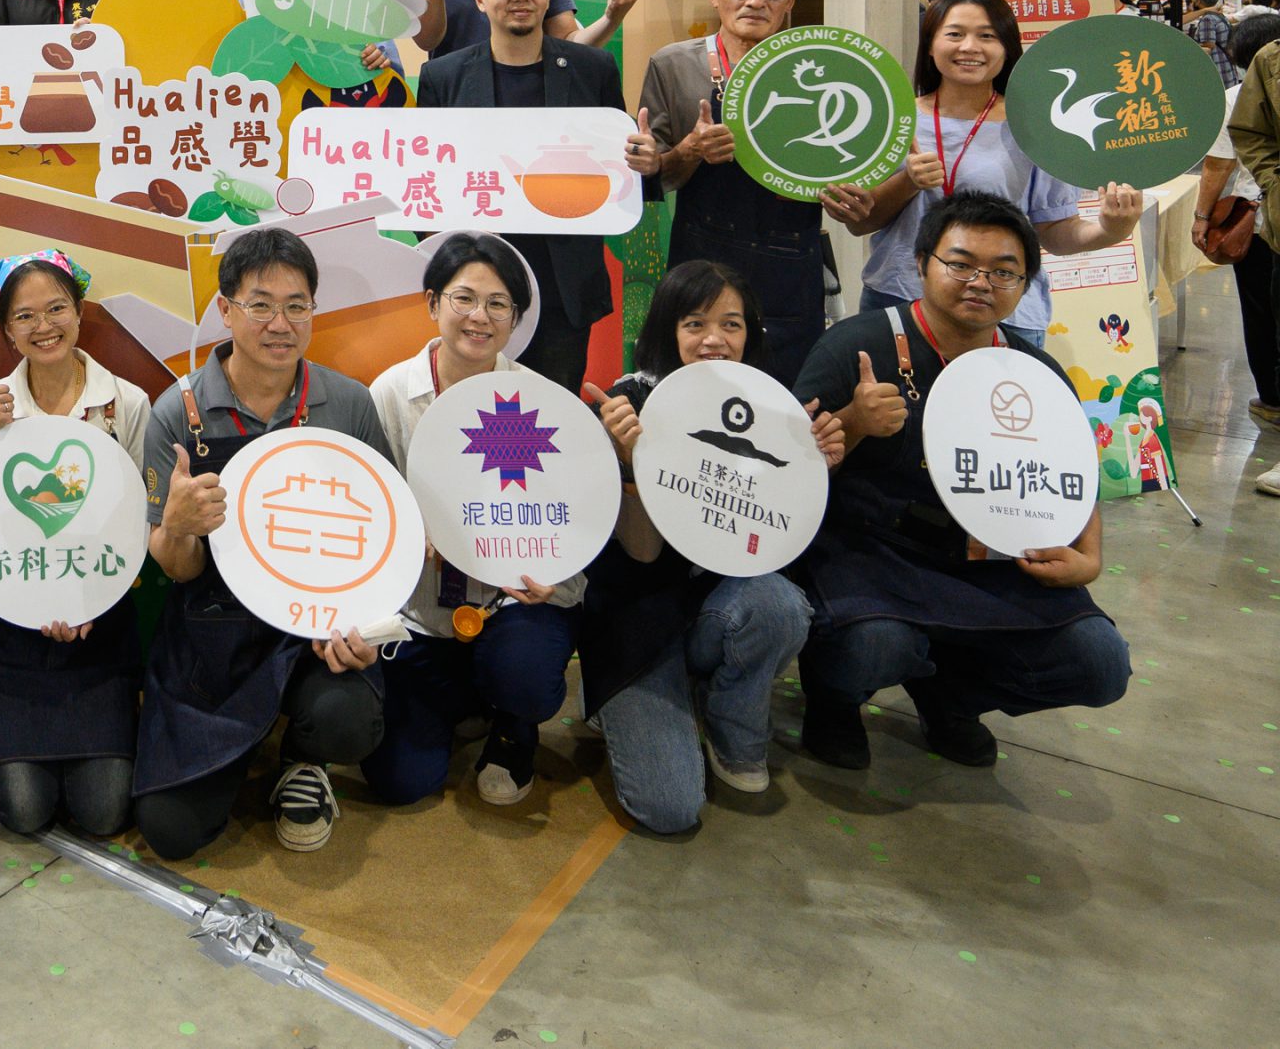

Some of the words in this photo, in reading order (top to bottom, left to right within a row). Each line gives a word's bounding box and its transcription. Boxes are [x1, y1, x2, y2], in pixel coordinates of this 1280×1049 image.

[726, 48, 769, 120] SIANG-TING
[771, 29, 839, 51] ORGANIC
[843, 33, 884, 60] FARM
[114, 78, 270, 118] Hualien
[111, 121, 271, 171] 品感覺
[302, 127, 456, 167] Hualien
[848, 162, 890, 188] FFEE
[886, 115, 912, 163] BEANS
[1105, 133, 1148, 150] ARCADIA
[1148, 127, 1188, 142] RESORT
[342, 170, 505, 219] 品感覺
[699, 458, 757, 491] 旦茶六十
[951, 448, 1083, 501] 里山微田
[656, 469, 791, 532] LIOUSHIHDAN
[989, 505, 1020, 517] SWEET
[1024, 510, 1055, 521] MANOR
[701, 507, 738, 535] TEA
[475, 537, 512, 558] NITA
[516, 532, 562, 558] CAFÉ
[288, 602, 338, 630] 917
